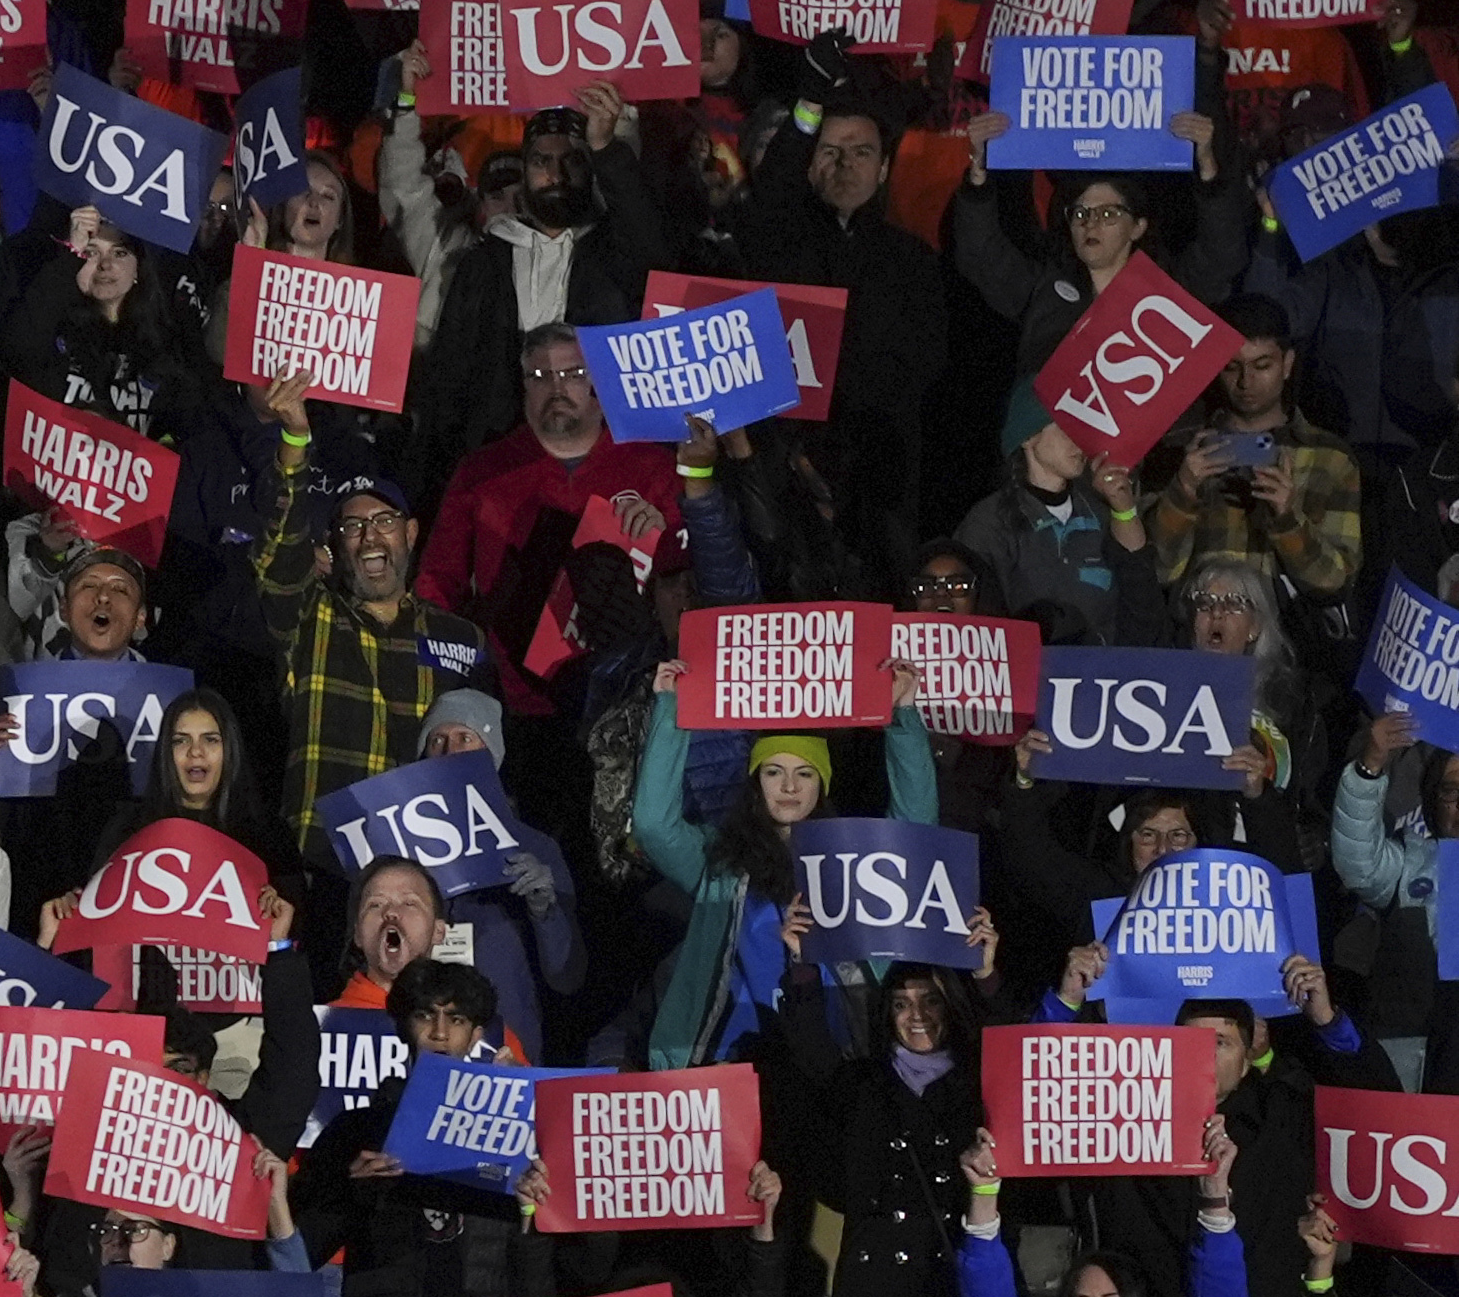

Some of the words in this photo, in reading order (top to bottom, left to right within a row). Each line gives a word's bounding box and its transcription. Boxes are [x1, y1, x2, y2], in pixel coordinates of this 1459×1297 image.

[1023, 47, 1095, 87] VOTE
[1105, 48, 1163, 89] FOR
[1020, 87, 1163, 129] FREEDOM
[50, 95, 190, 223] USA
[1056, 294, 1212, 439] USA
[23, 411, 152, 502] HARRIS
[35, 466, 124, 522] WALZ
[718, 611, 853, 646] FREEDOM
[427, 639, 477, 665] HARRIS
[440, 658, 471, 678] WALZ
[717, 646, 853, 682] FREEDOM
[716, 681, 853, 718] FREEDOM
[1049, 679, 1232, 756] USA
[79, 850, 260, 930] USA
[801, 852, 971, 935] USA
[1022, 1037, 1172, 1078] FREEDOM
[1022, 1078, 1172, 1120] FREEDOM
[1023, 1119, 1173, 1164] FREEDOM
